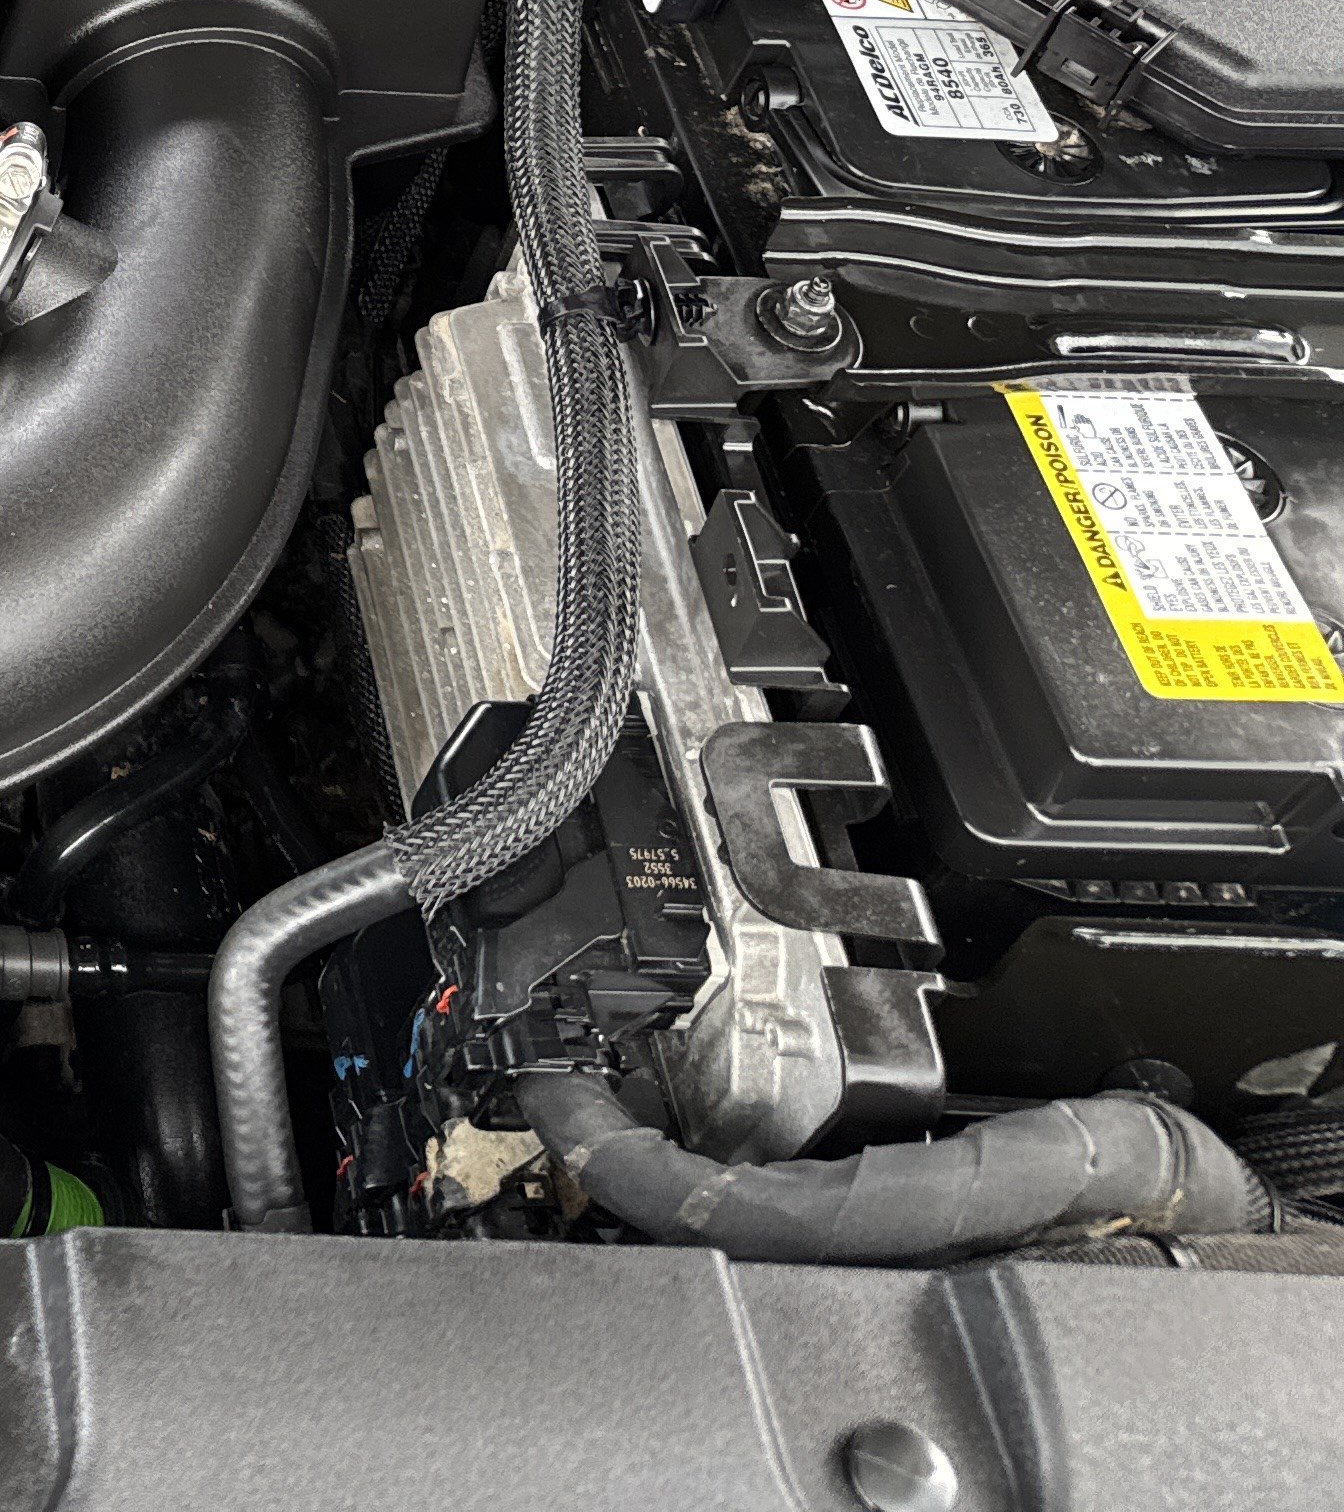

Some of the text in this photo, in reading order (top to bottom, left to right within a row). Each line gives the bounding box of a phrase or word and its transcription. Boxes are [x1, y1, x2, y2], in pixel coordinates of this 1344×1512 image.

[846, 24, 910, 122] ACDelco
[911, 52, 945, 101] 94RAGM
[929, 56, 965, 99] 8540
[988, 65, 1013, 94] 80Ah
[1008, 103, 1028, 124] 730
[1023, 413, 1117, 568] DANGER/POISON
